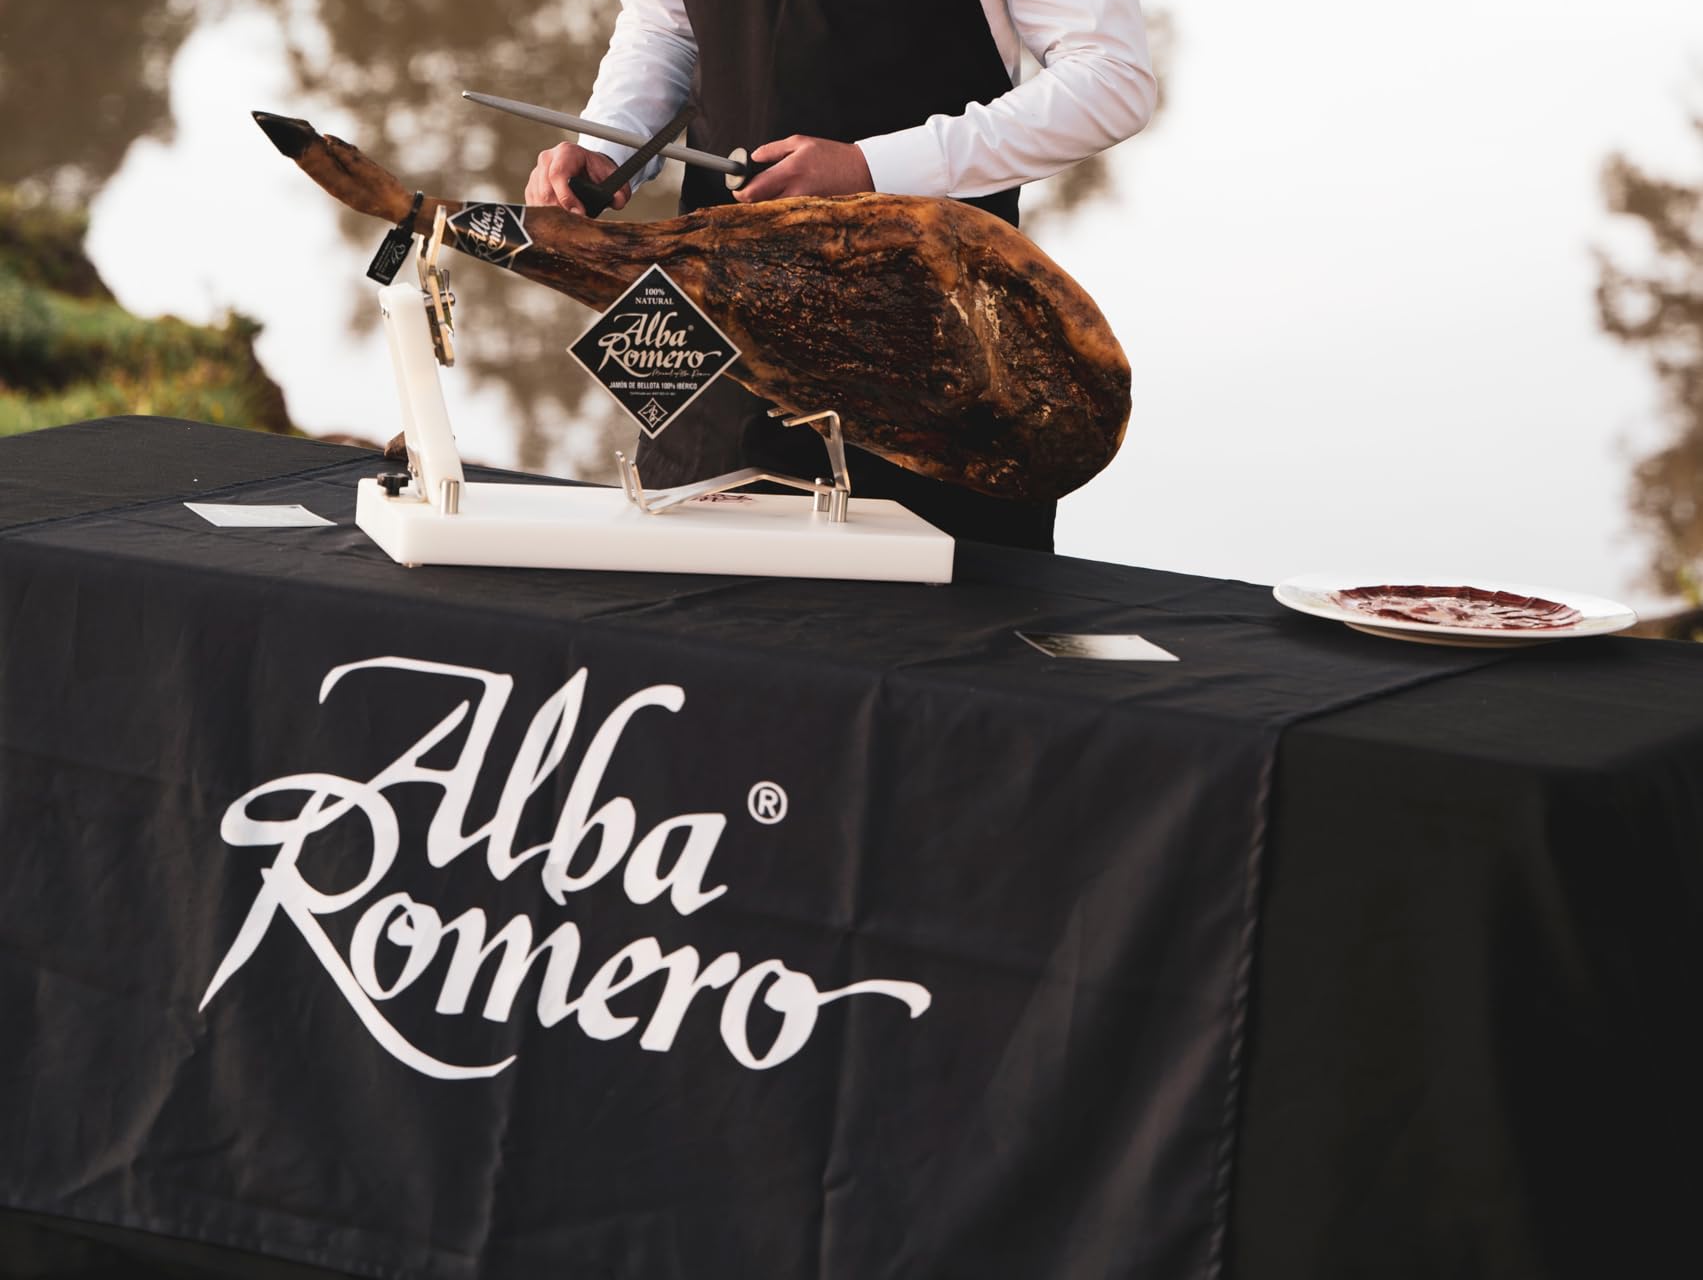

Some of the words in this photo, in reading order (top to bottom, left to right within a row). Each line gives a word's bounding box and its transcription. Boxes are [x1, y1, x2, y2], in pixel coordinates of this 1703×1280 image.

[467, 211, 493, 245] Alba
[635, 297, 674, 305] NATURAL
[644, 288, 665, 296] 100%
[614, 310, 688, 348] Alba
[597, 333, 722, 378] Romero
[609, 380, 628, 389] JAMÓN
[629, 381, 635, 389] DE
[637, 381, 660, 389] BELLOTA
[319, 656, 729, 916] Alba
[199, 773, 932, 1080] Romero
